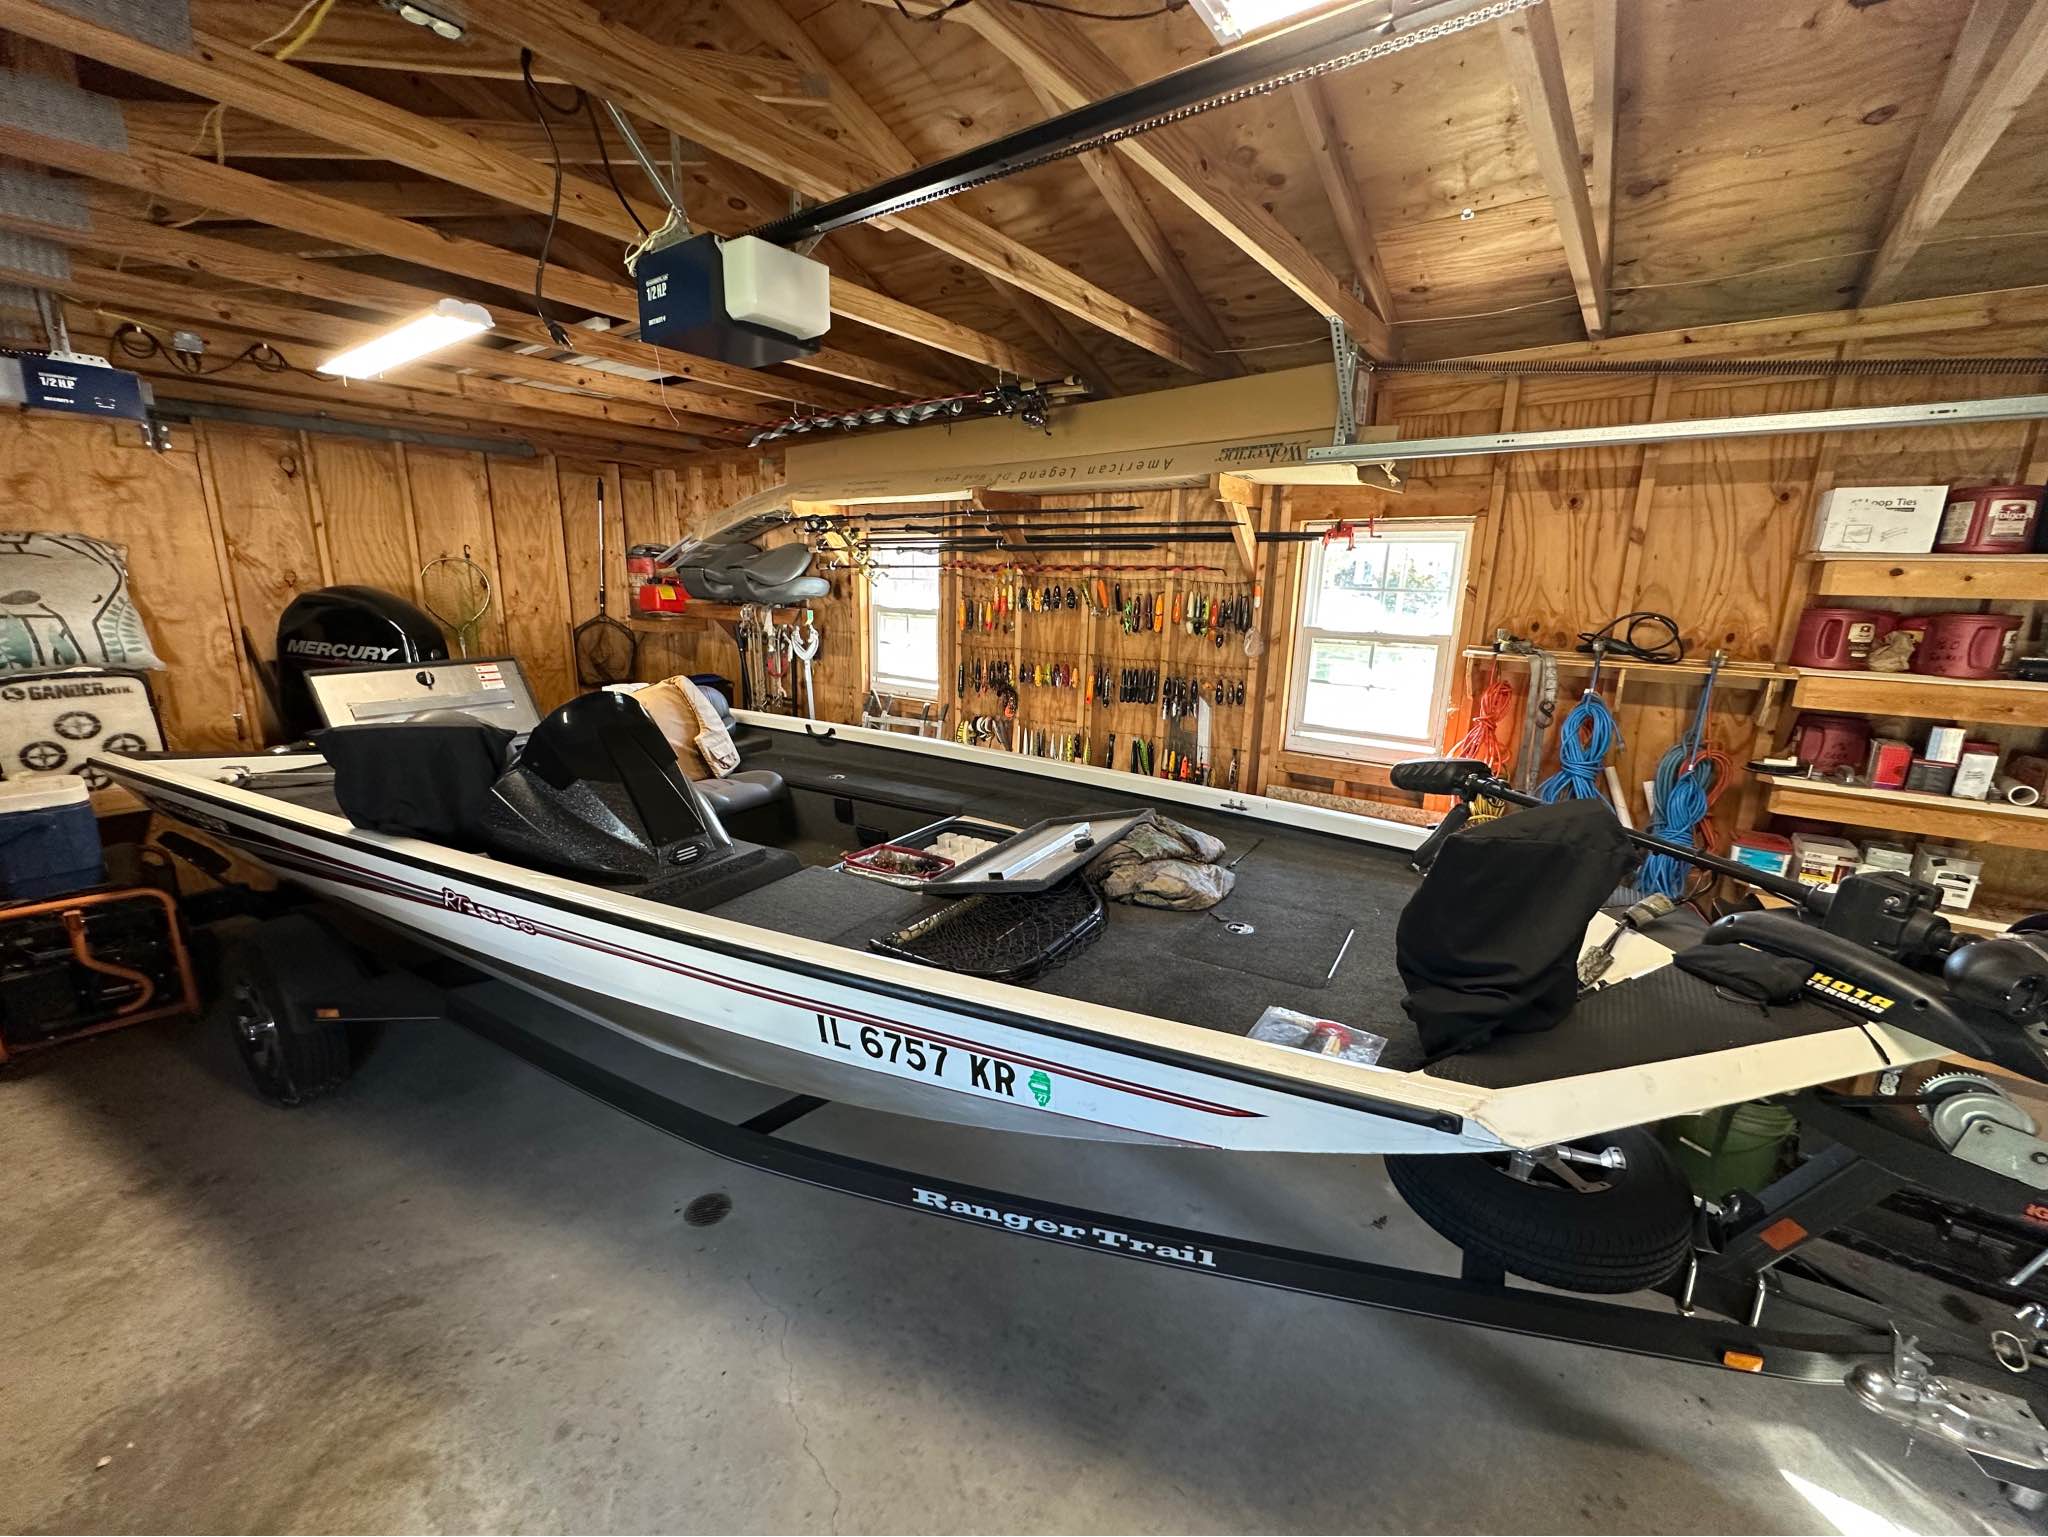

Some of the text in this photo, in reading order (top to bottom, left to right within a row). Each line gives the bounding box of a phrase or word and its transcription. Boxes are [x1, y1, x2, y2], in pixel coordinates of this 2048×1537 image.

[1087, 457, 1174, 476] American
[287, 639, 399, 661] MERCURY
[27, 682, 106, 700] GANDER
[1805, 979, 1885, 1014] TERROVA
[1810, 972, 1895, 1010] KOTA
[816, 1013, 851, 1050] IL
[860, 1026, 948, 1077] 6757
[970, 1053, 1017, 1098] KR
[912, 1187, 1217, 1268] Ranger Trail
